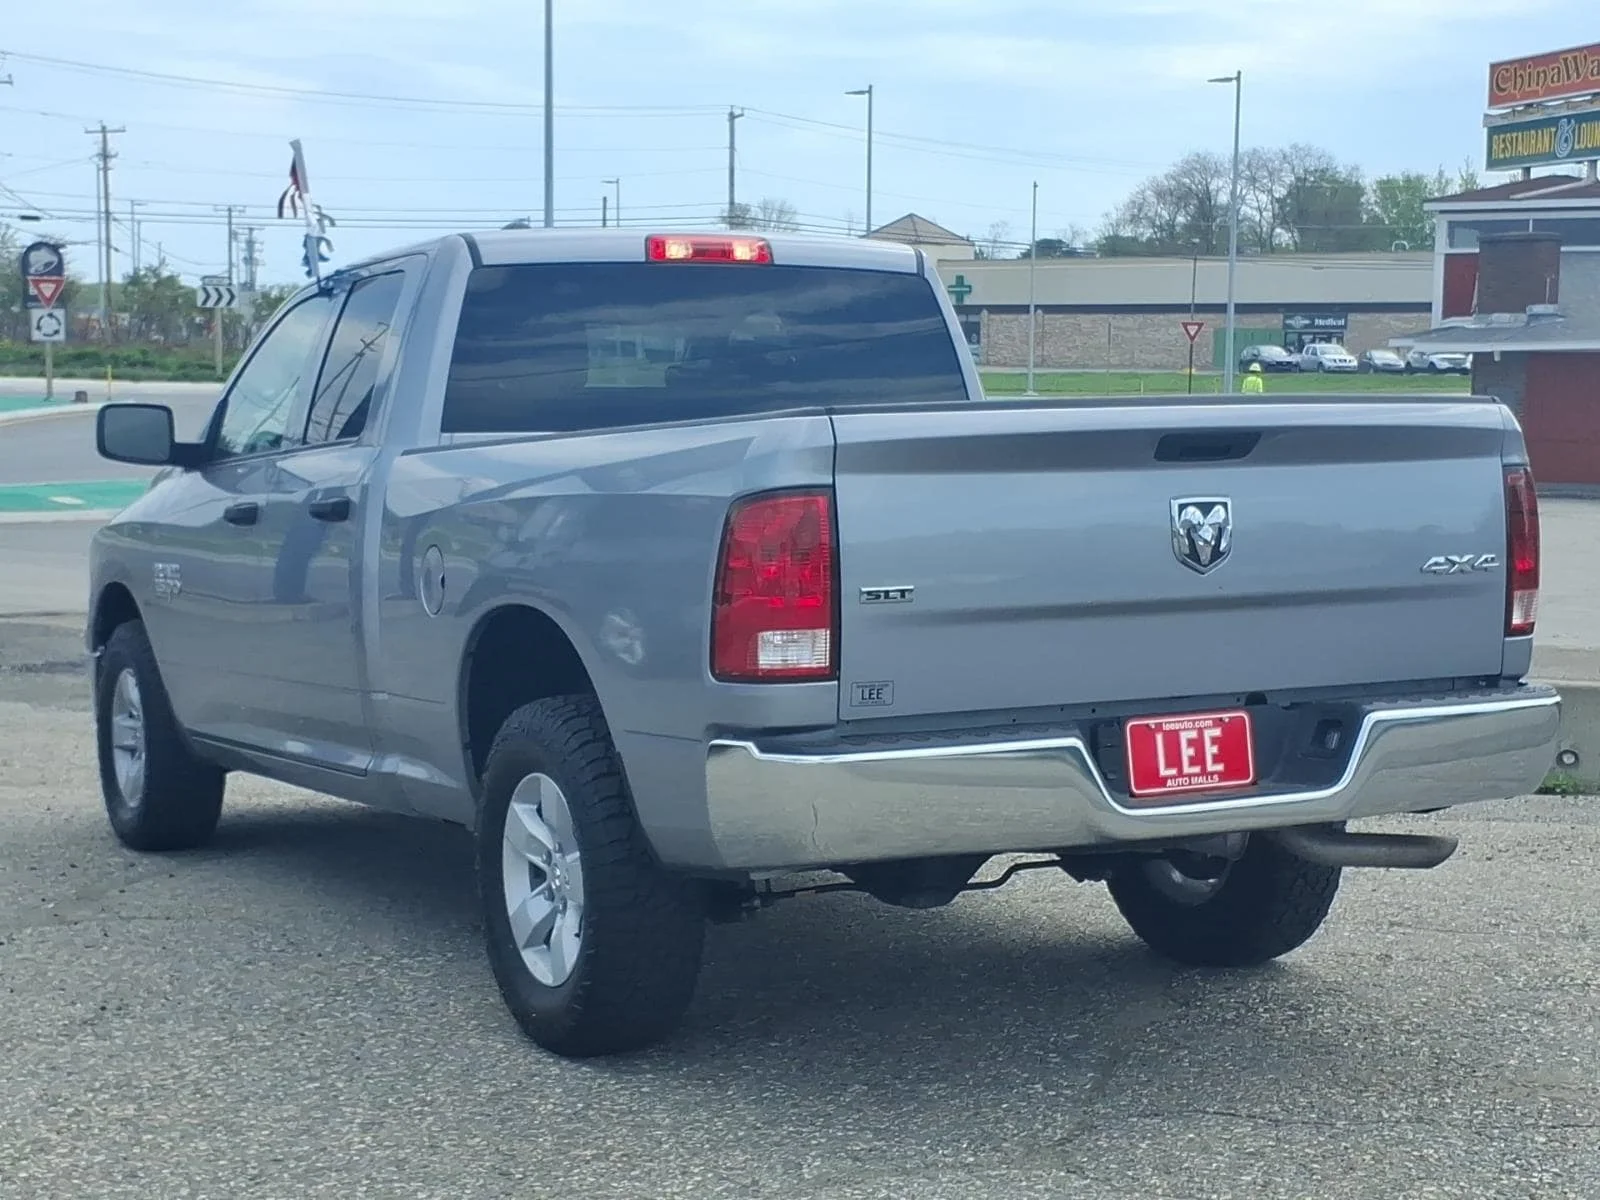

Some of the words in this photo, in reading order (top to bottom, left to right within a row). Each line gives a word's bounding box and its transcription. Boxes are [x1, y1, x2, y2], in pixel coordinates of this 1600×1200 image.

[1492, 128, 1557, 159] RESTAURANT
[864, 588, 914, 601] SLT
[861, 687, 884, 700] LEE
[1155, 727, 1225, 777] LEE
[1166, 777, 1190, 788] AUTO
[1191, 774, 1219, 785] MALLS
